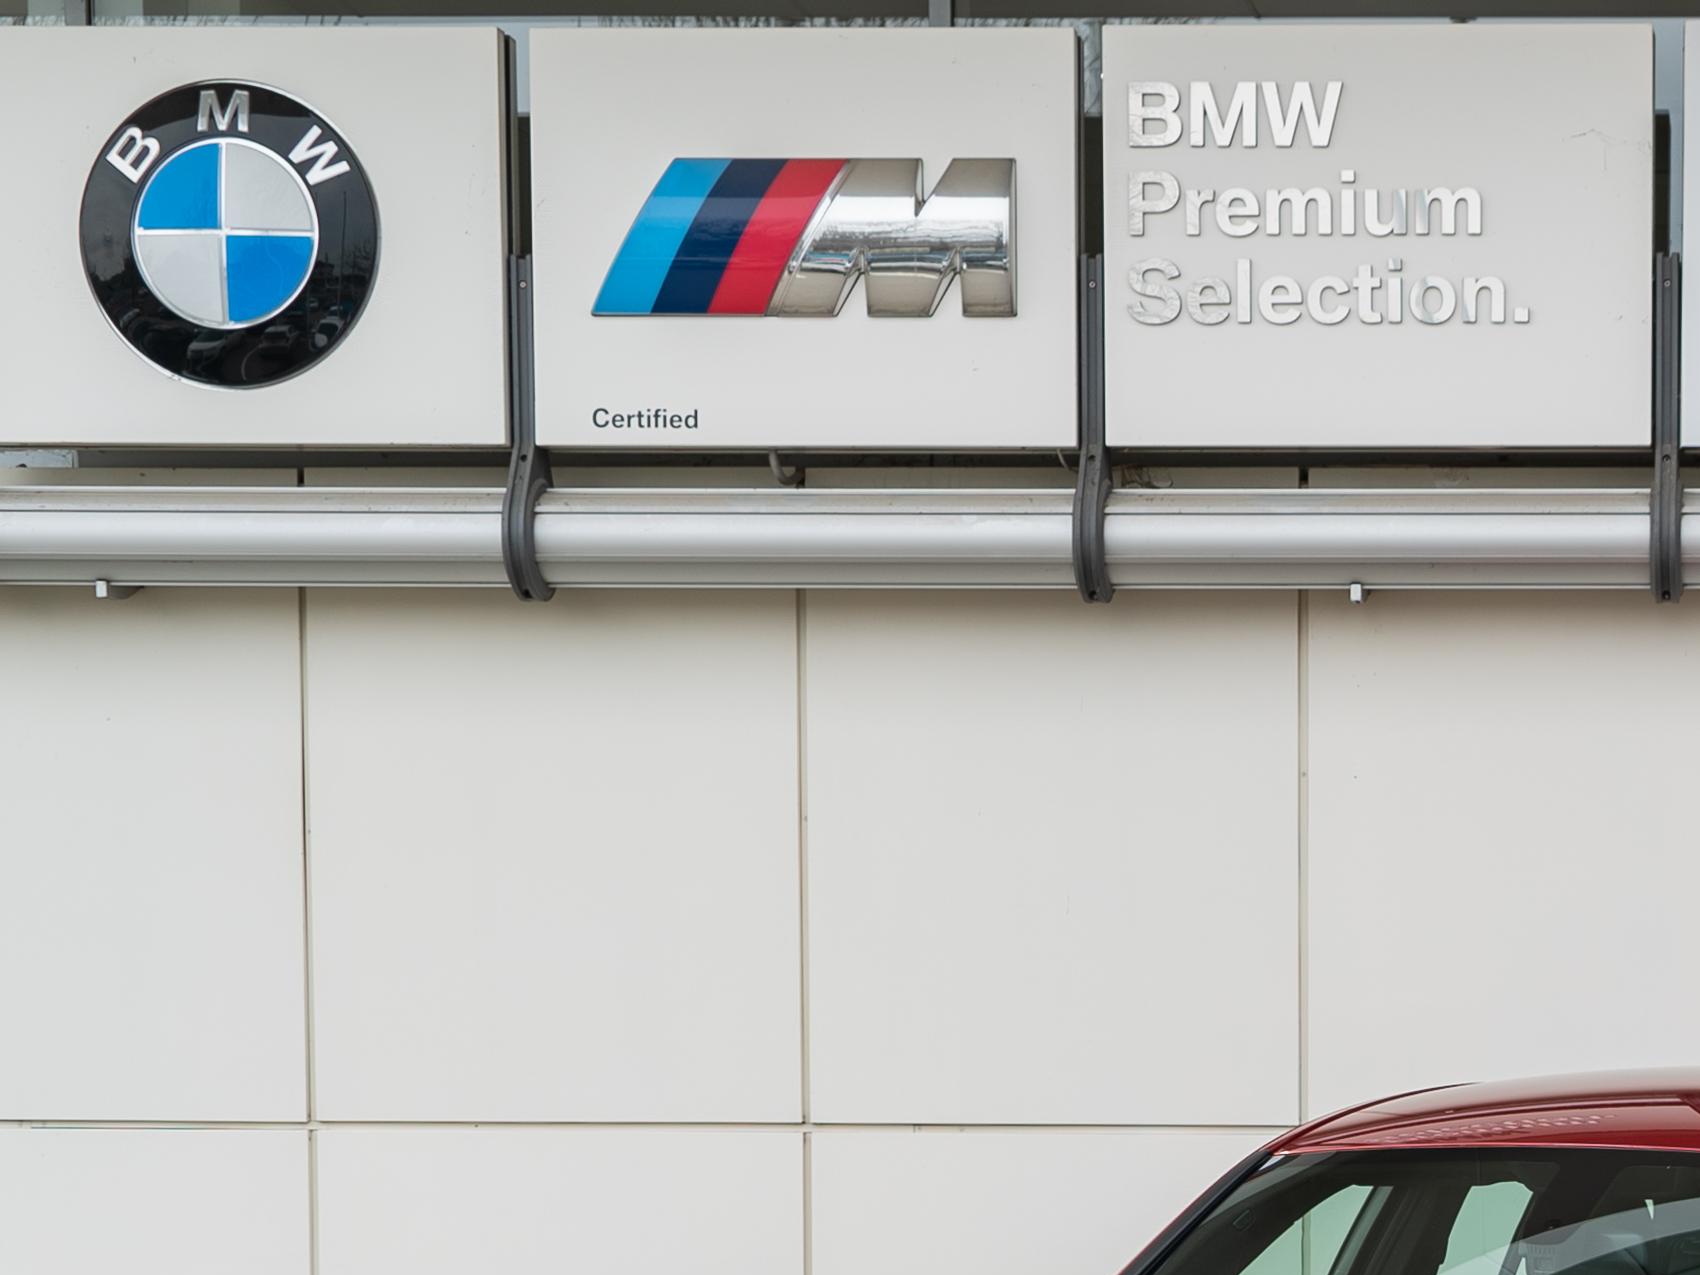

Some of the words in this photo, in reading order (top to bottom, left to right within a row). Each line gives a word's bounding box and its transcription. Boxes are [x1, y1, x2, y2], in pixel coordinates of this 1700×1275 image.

[105, 89, 350, 186] BMW
[1127, 81, 1344, 149] BMW
[1127, 169, 1483, 237] Premium
[1127, 257, 1531, 325] Selection.
[592, 408, 699, 429] Certified
